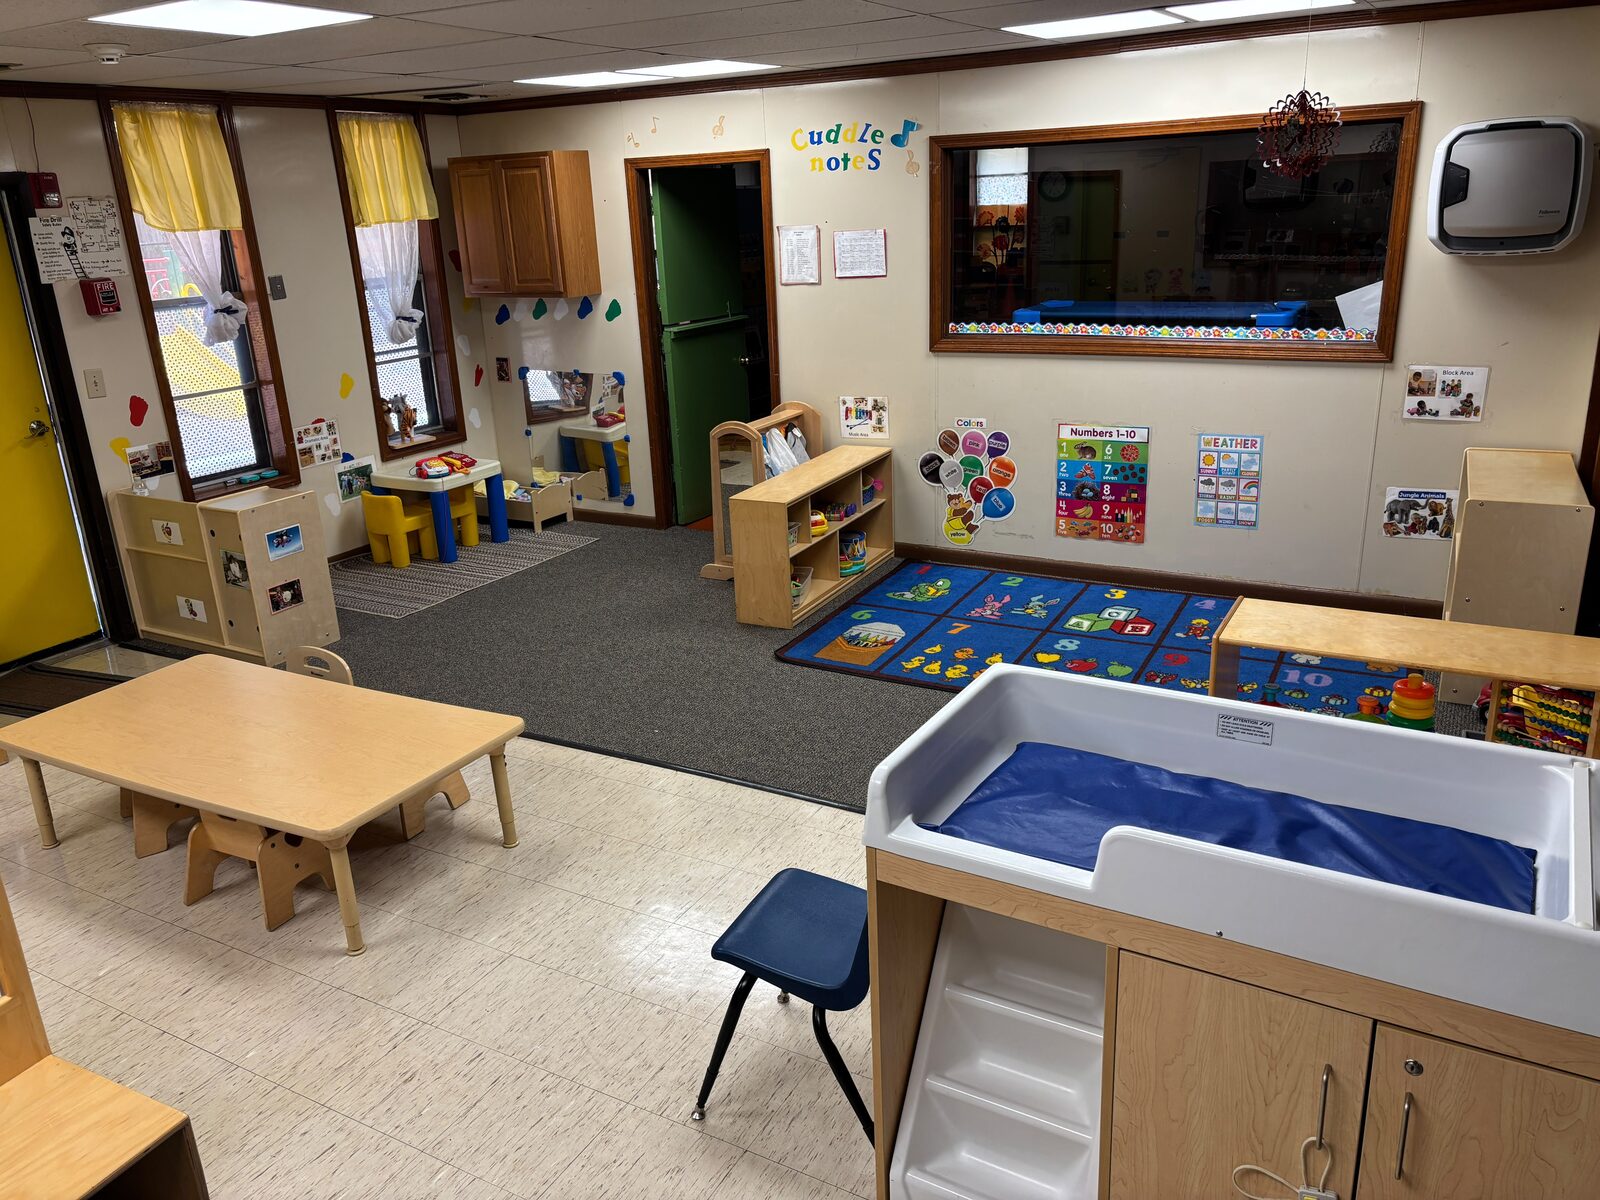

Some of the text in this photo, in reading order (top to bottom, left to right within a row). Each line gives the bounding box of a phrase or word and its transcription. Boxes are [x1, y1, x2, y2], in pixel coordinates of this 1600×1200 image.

[96, 282, 114, 291] FIRE
[956, 419, 984, 427] Colors
[1070, 427, 1113, 438] Numbers
[968, 440, 980, 448] pink
[1061, 442, 1067, 453] 1
[1202, 437, 1258, 449] WEATHER
[1105, 444, 1113, 455] 6
[925, 461, 939, 472] black
[1060, 462, 1067, 472] 2
[1104, 464, 1112, 475] 7
[944, 468, 958, 478] white
[992, 467, 1012, 478] orange
[976, 485, 988, 494] red
[1060, 481, 1067, 491] 3
[1103, 484, 1111, 495] 8
[1399, 492, 1420, 500] Jungle
[993, 497, 1004, 510] blue
[1059, 500, 1067, 511] 4
[1102, 504, 1110, 515] 9
[1059, 519, 1066, 529] 5
[1100, 523, 1114, 534] 10
[1000, 576, 1024, 587] 2
[1104, 589, 1128, 599] 3
[1194, 599, 1216, 610] 4
[850, 609, 877, 620] 6
[946, 622, 972, 634] 7
[1067, 621, 1084, 629] A
[1130, 625, 1146, 634] B
[1053, 638, 1081, 651] 8
[1162, 653, 1189, 666] 9
[1283, 669, 1333, 687] 10
[1233, 716, 1259, 725] ATTENTION
